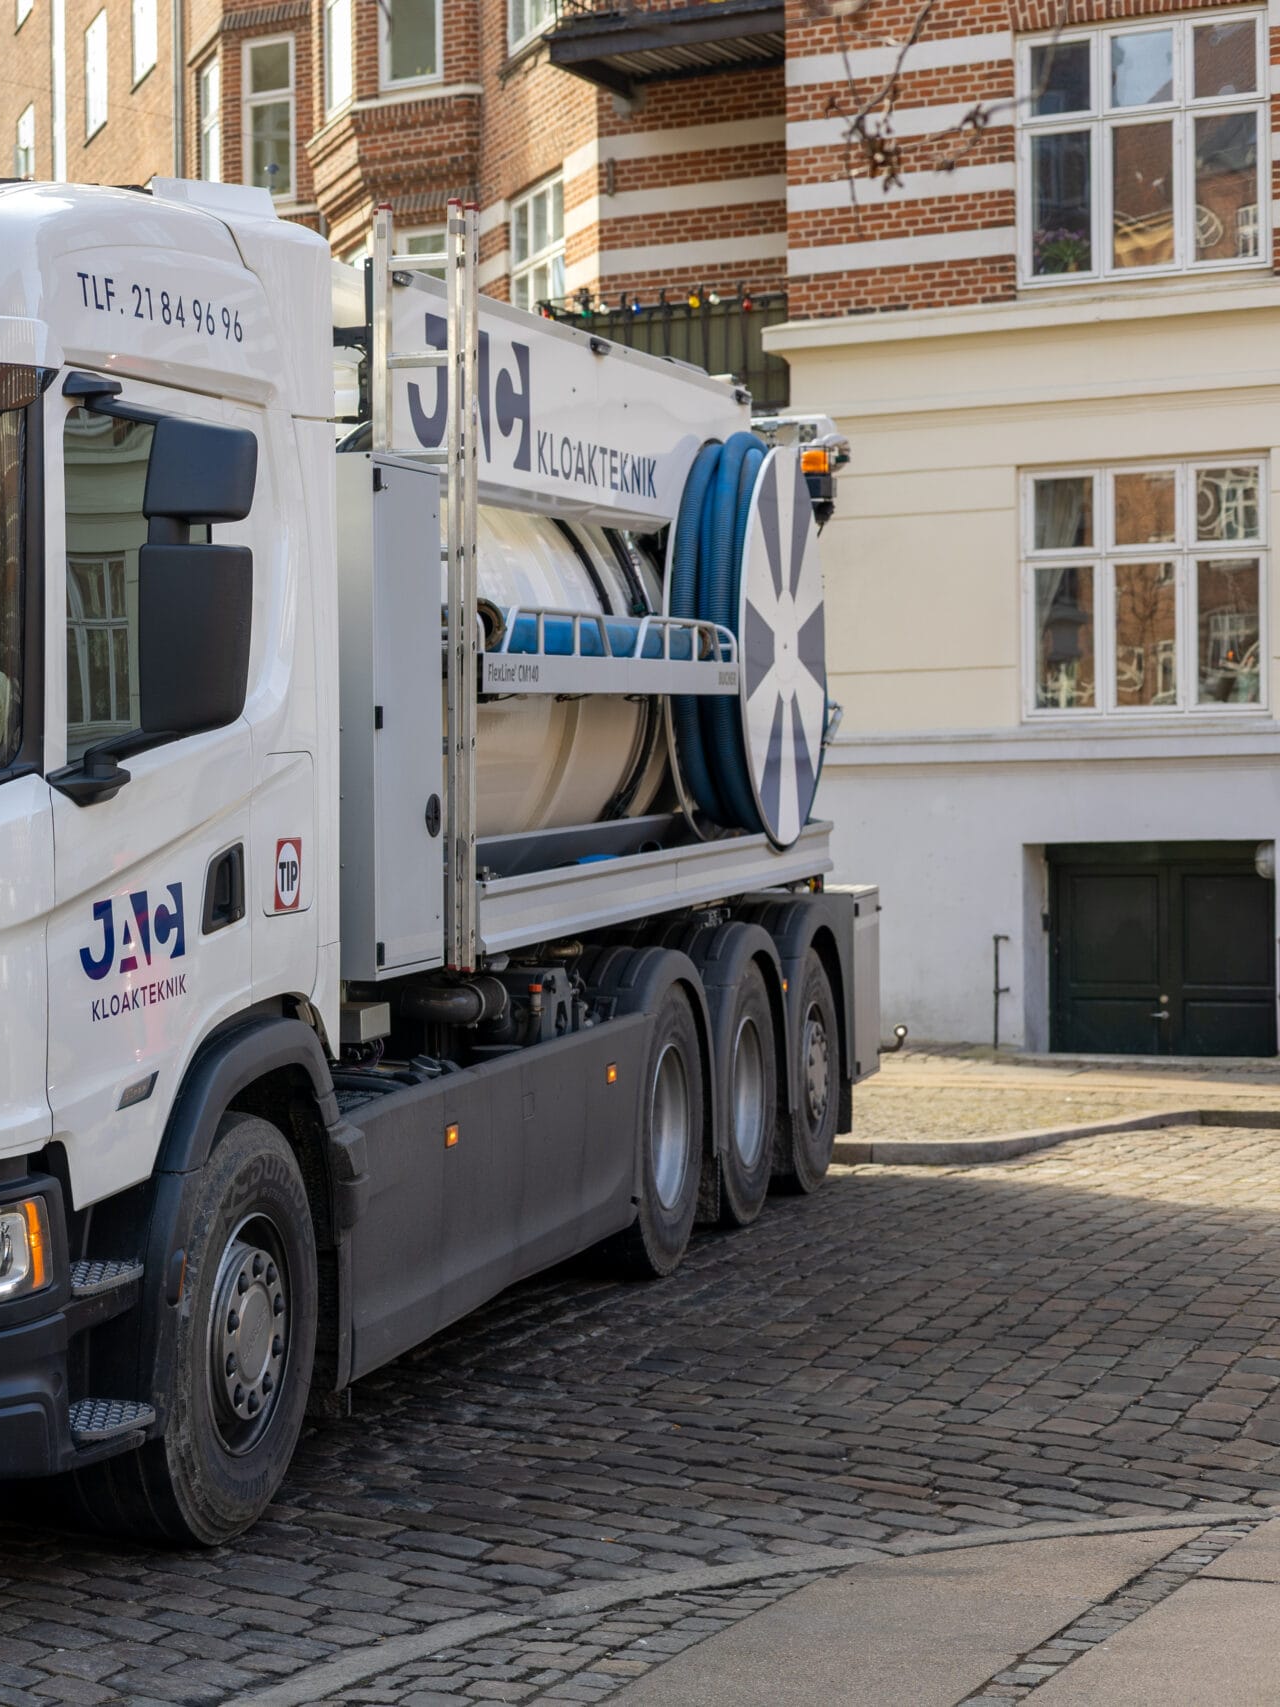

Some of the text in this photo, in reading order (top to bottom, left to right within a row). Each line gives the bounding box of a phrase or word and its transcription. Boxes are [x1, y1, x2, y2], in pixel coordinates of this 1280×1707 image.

[77, 272, 243, 342] TLF. 21 84 96 96
[537, 430, 657, 499] KLOAKTEKNIK
[279, 861, 298, 892] TIP
[79, 882, 185, 980] JAC
[92, 974, 187, 1022] KLOAKTEKNIK
